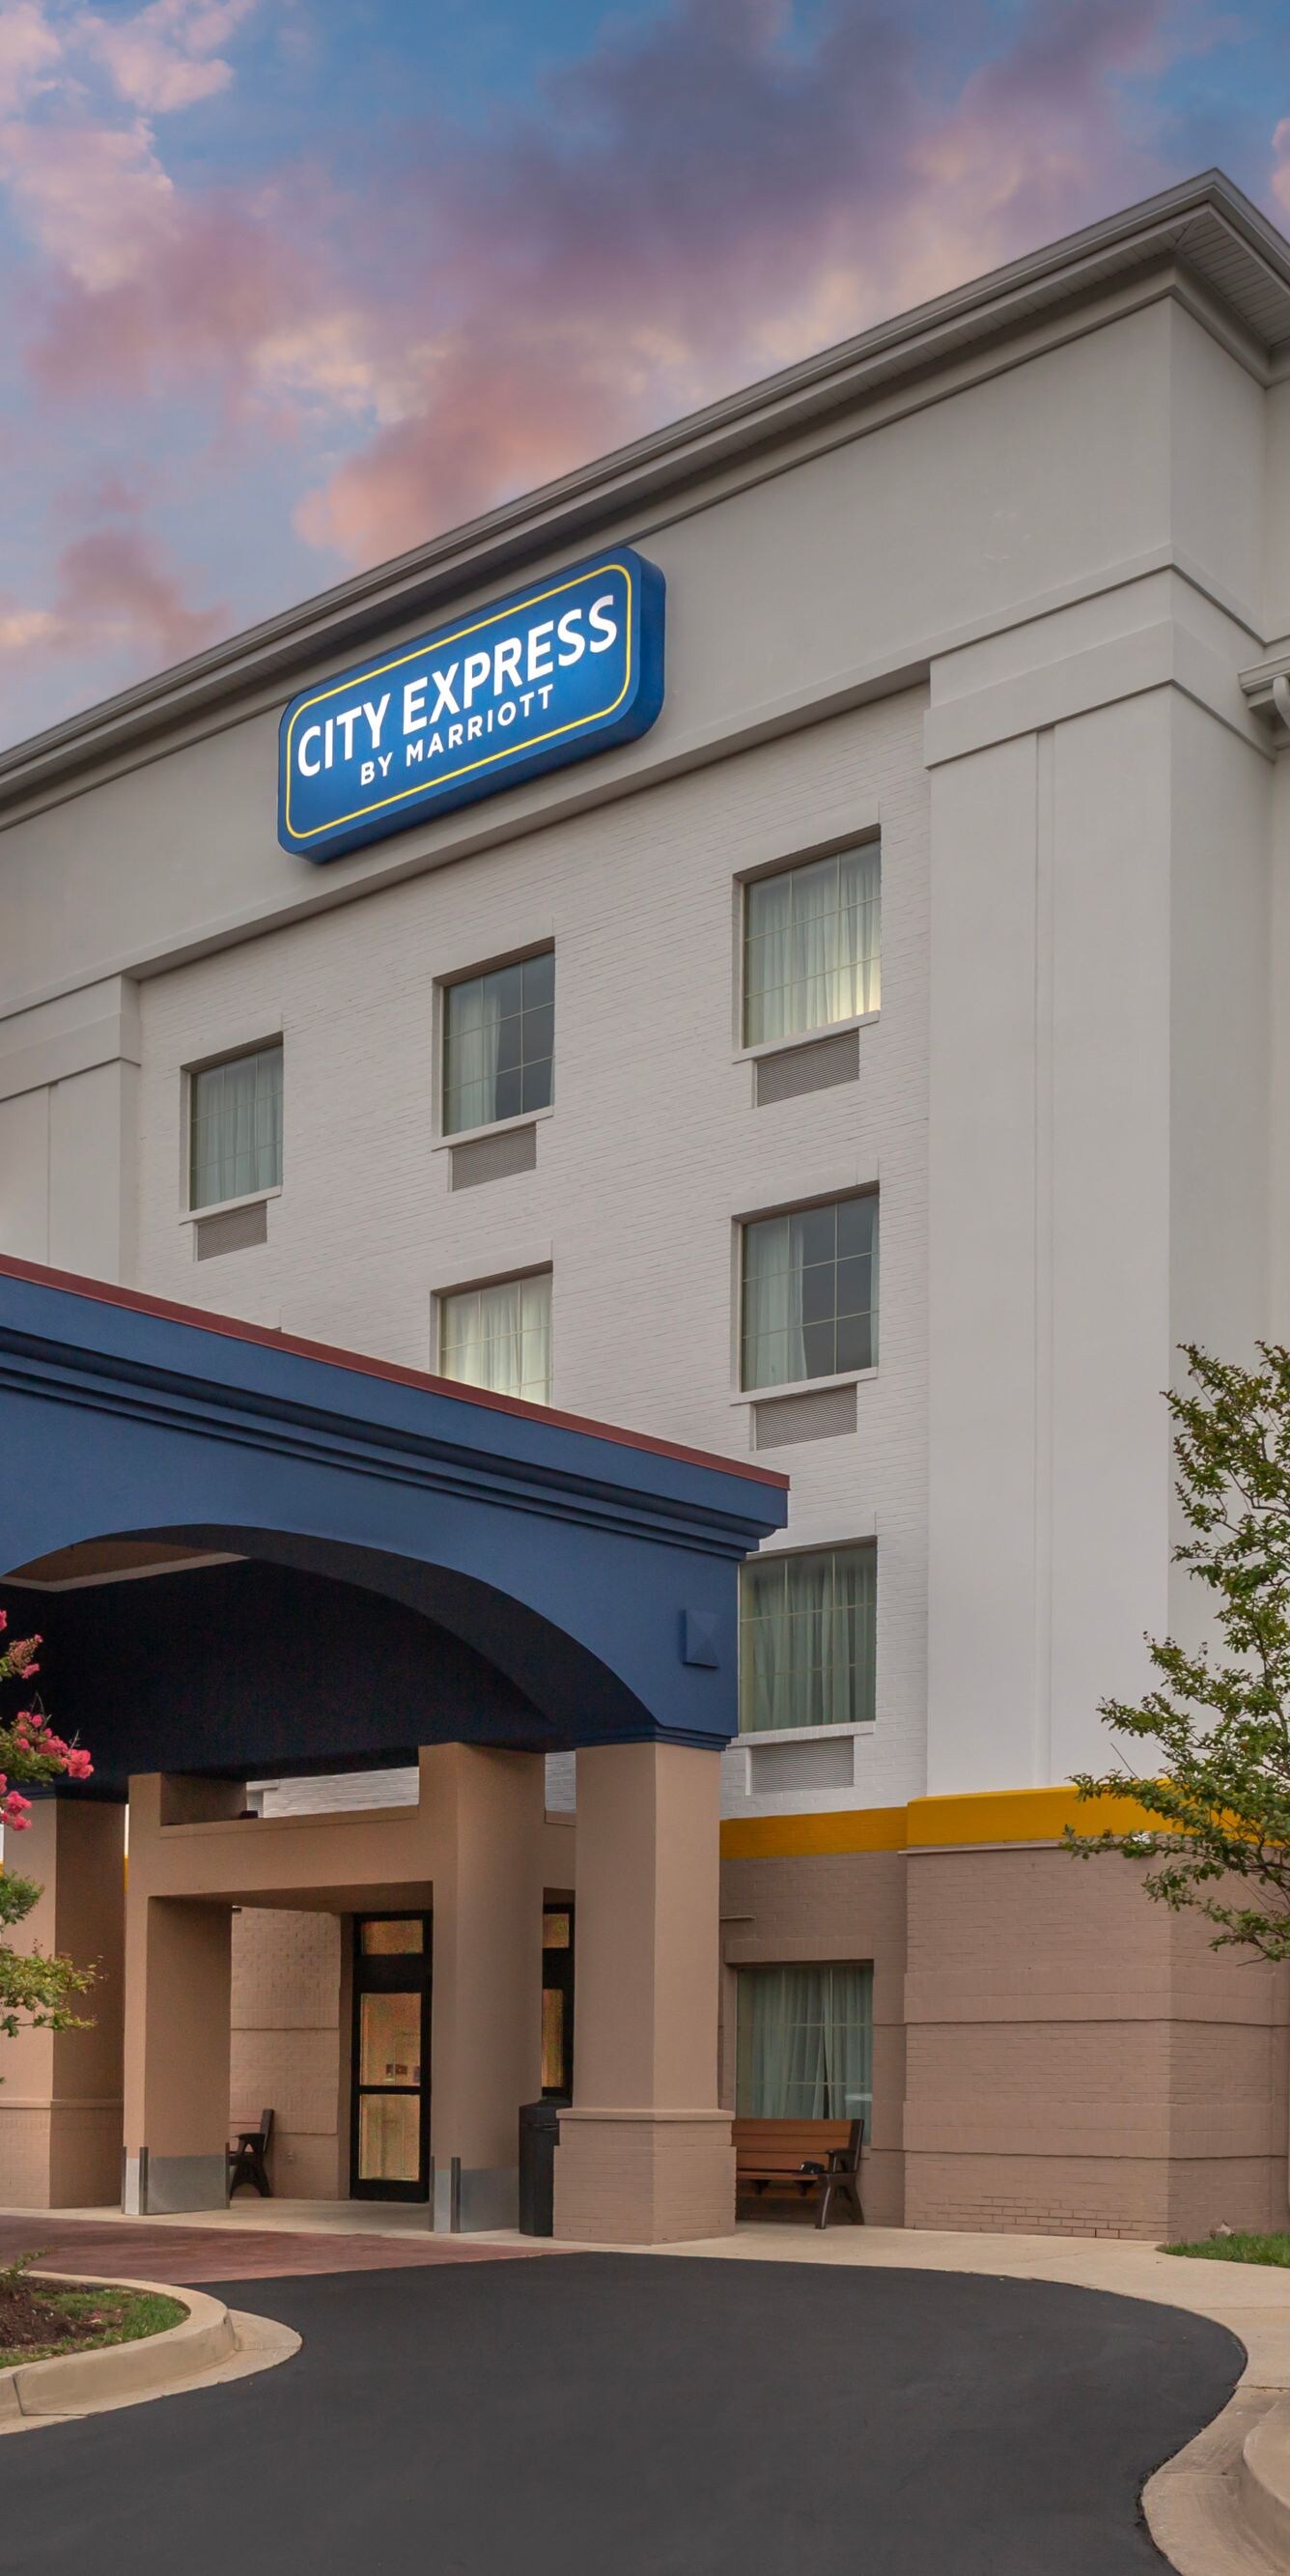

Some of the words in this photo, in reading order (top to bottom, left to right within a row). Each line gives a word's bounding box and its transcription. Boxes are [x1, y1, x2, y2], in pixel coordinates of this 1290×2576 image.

[297, 693, 391, 777] CITY
[403, 594, 618, 735] EXPRESS
[360, 751, 393, 786] BY
[406, 684, 553, 767] MARRIOTT
